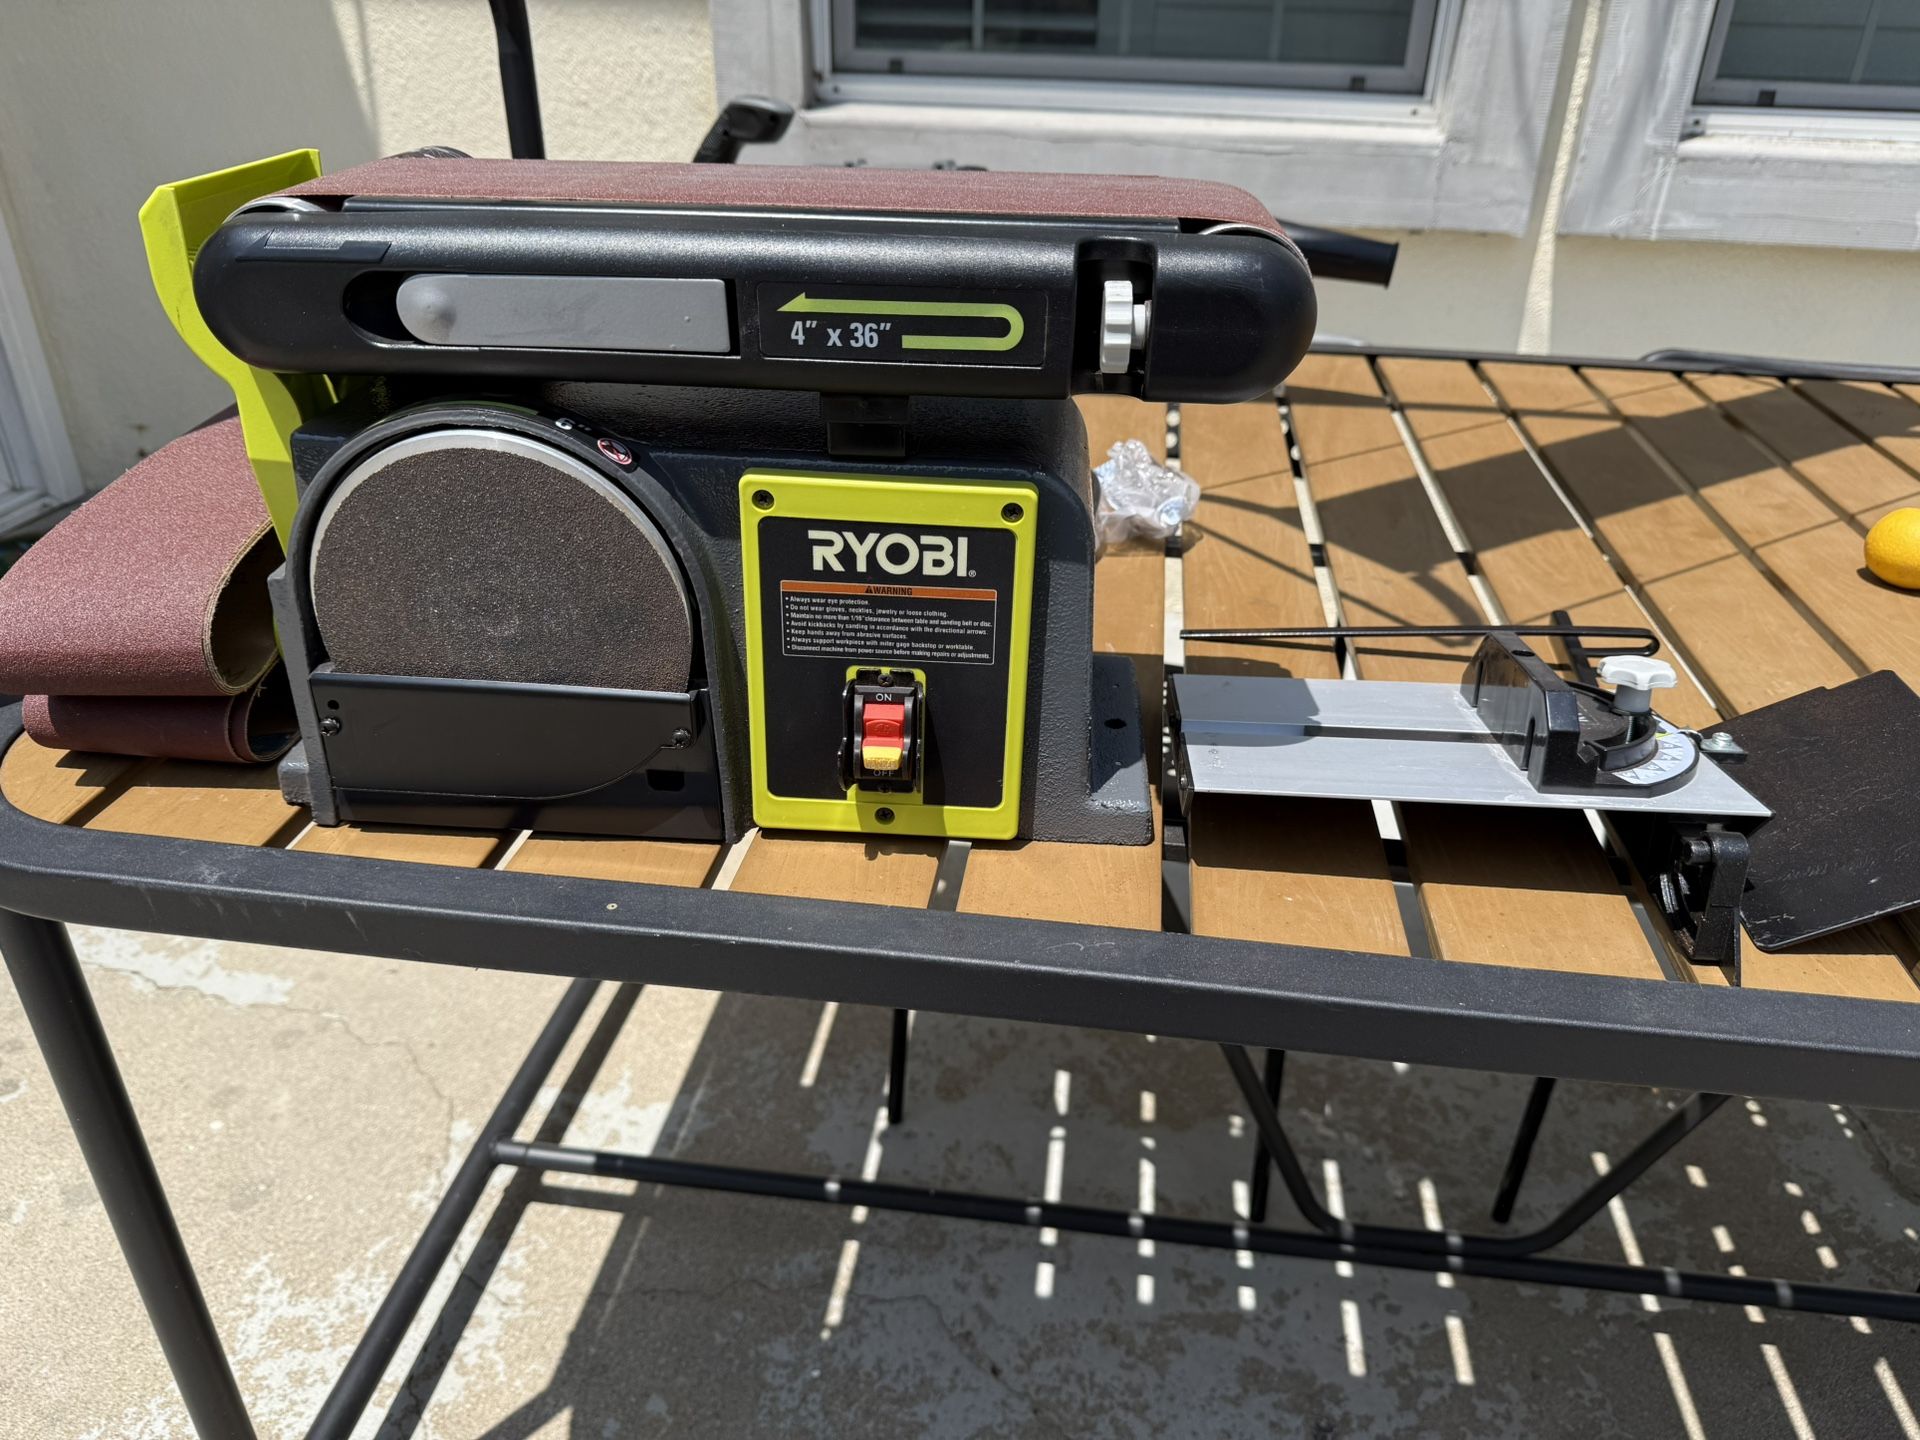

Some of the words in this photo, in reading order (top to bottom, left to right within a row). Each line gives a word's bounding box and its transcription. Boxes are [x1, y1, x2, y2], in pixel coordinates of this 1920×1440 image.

[826, 328, 843, 347] x
[874, 586, 913, 596] WARNING
[876, 693, 892, 702] ON
